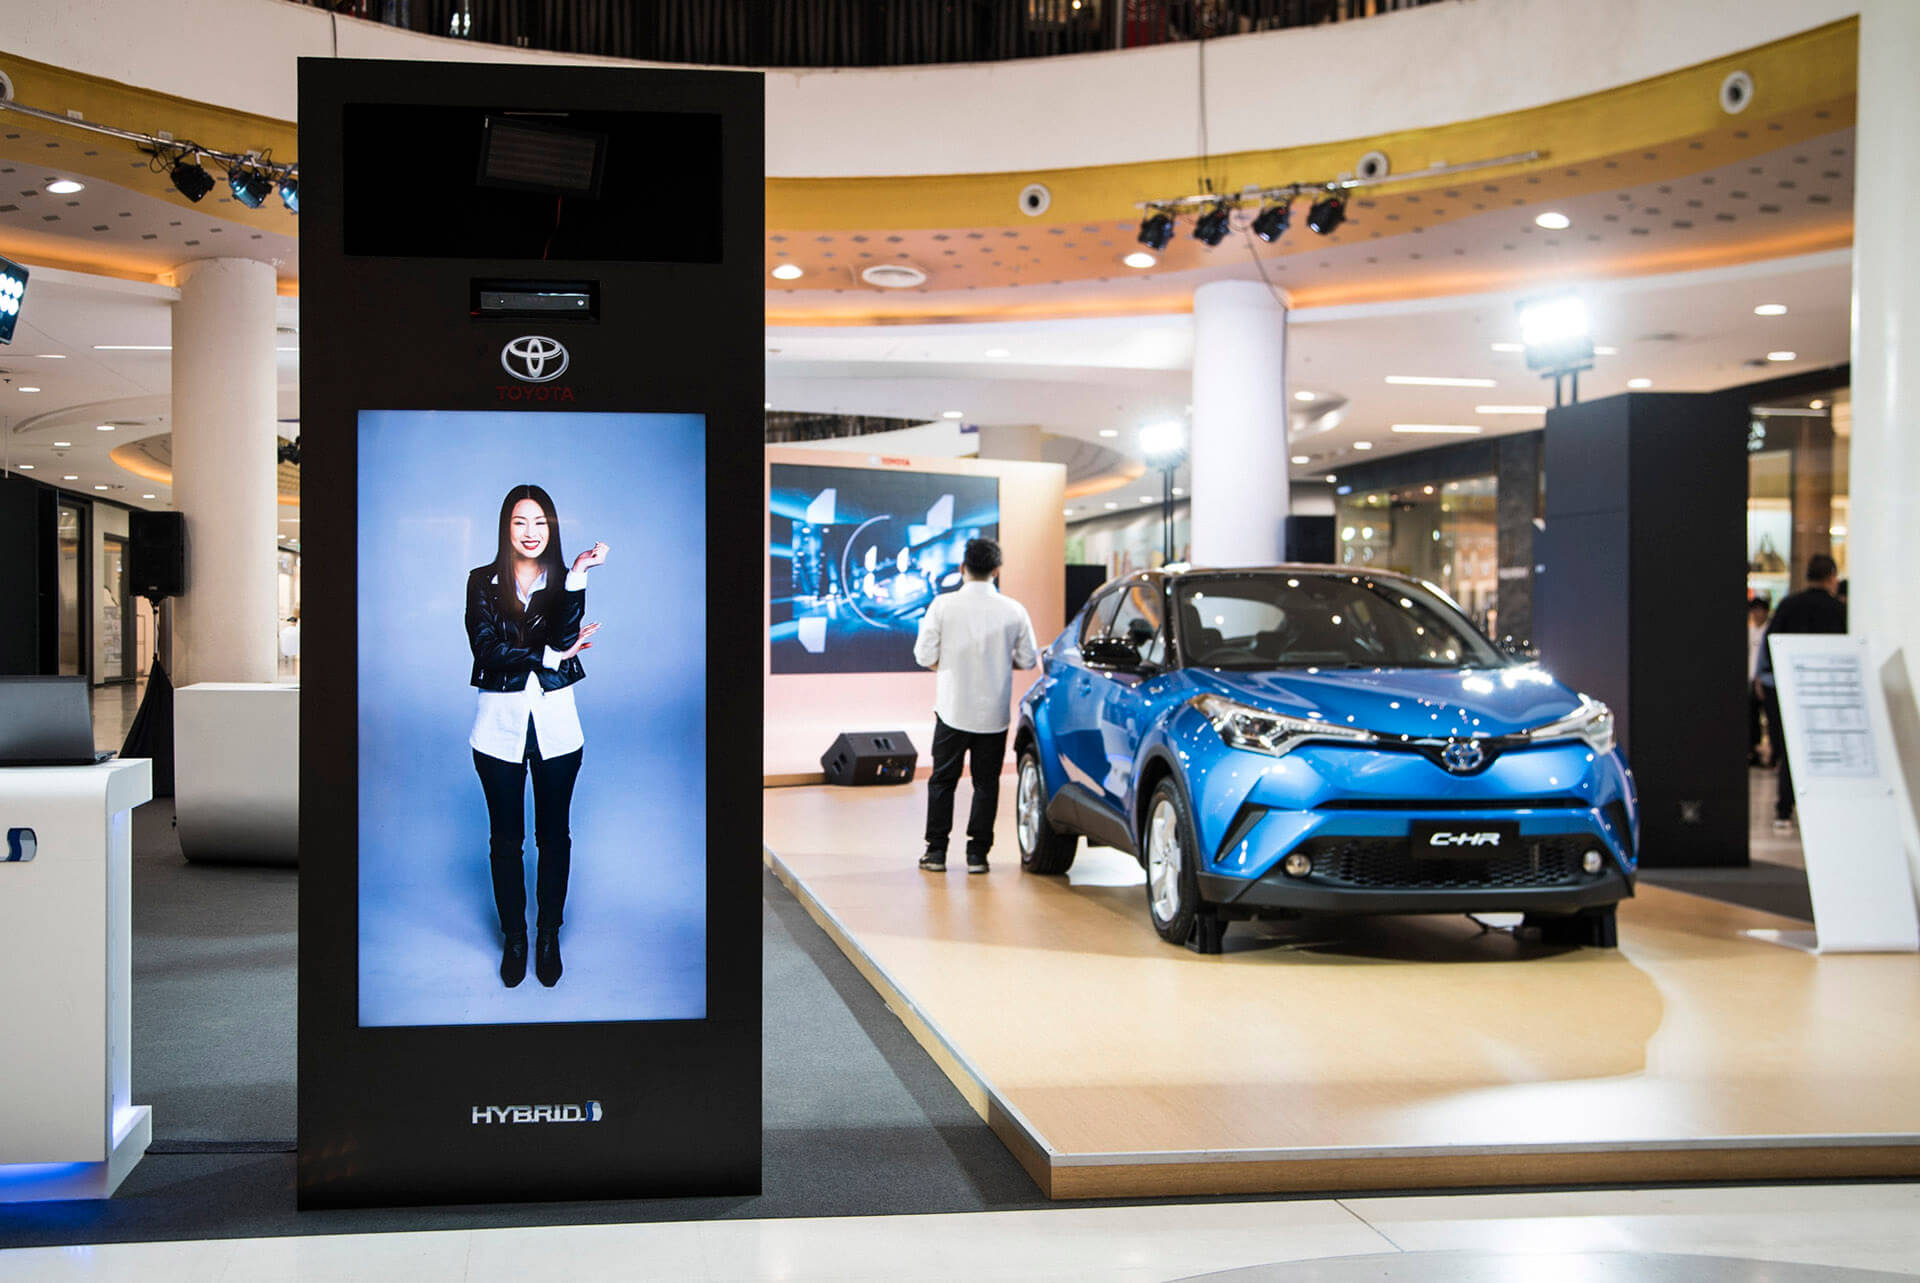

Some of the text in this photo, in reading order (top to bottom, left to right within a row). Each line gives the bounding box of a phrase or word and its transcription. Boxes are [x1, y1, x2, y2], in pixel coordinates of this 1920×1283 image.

[496, 385, 574, 401] TOYOTA
[1429, 832, 1501, 846] C-HR
[472, 1104, 583, 1124] HYBRID
